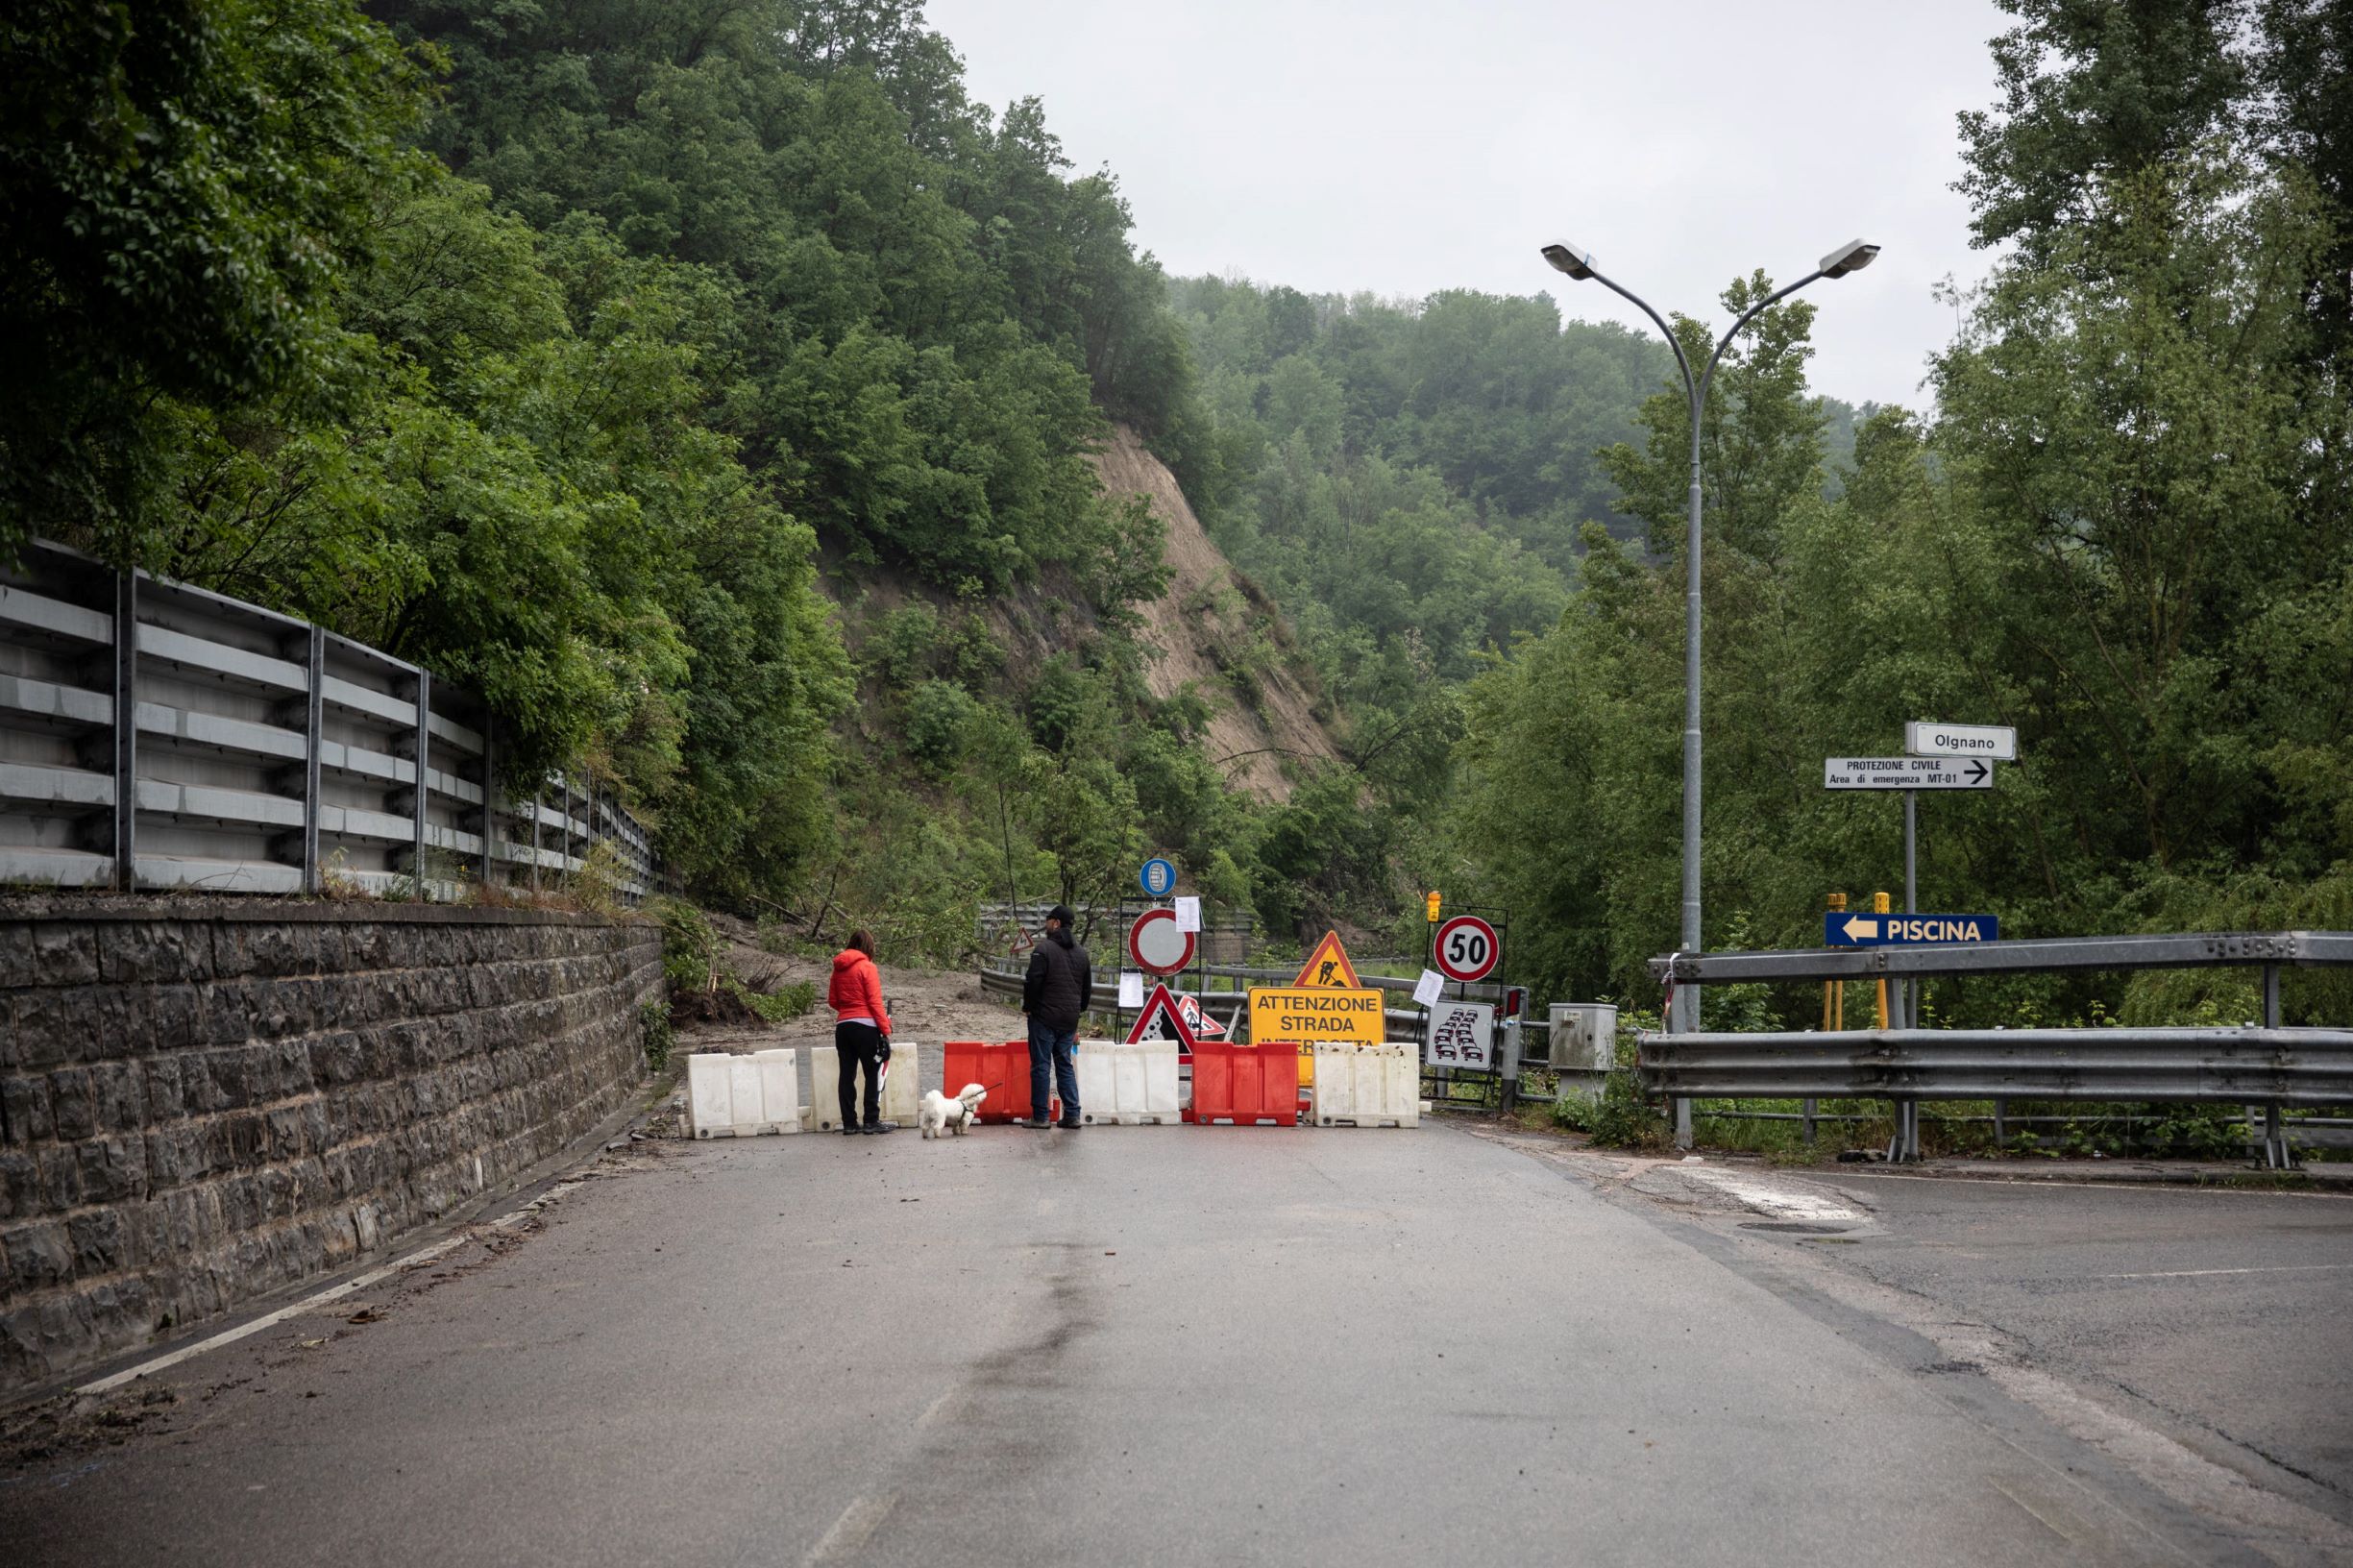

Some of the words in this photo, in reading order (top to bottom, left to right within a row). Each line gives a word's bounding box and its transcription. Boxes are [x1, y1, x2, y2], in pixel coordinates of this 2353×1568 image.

[1935, 734, 1995, 749] Olgnano
[1847, 760, 1904, 771] PROTEZIONE
[1911, 760, 1941, 770] CIVILE
[1829, 773, 1851, 784] Area
[1857, 773, 1866, 784] di
[1873, 775, 1921, 786] emergenza
[1927, 773, 1957, 784] MT-01
[1888, 919, 1981, 942] PISCINA
[1448, 933, 1486, 966] 50
[1257, 995, 1378, 1013] ATTENZIONE
[1280, 1016, 1356, 1033] STRADA
